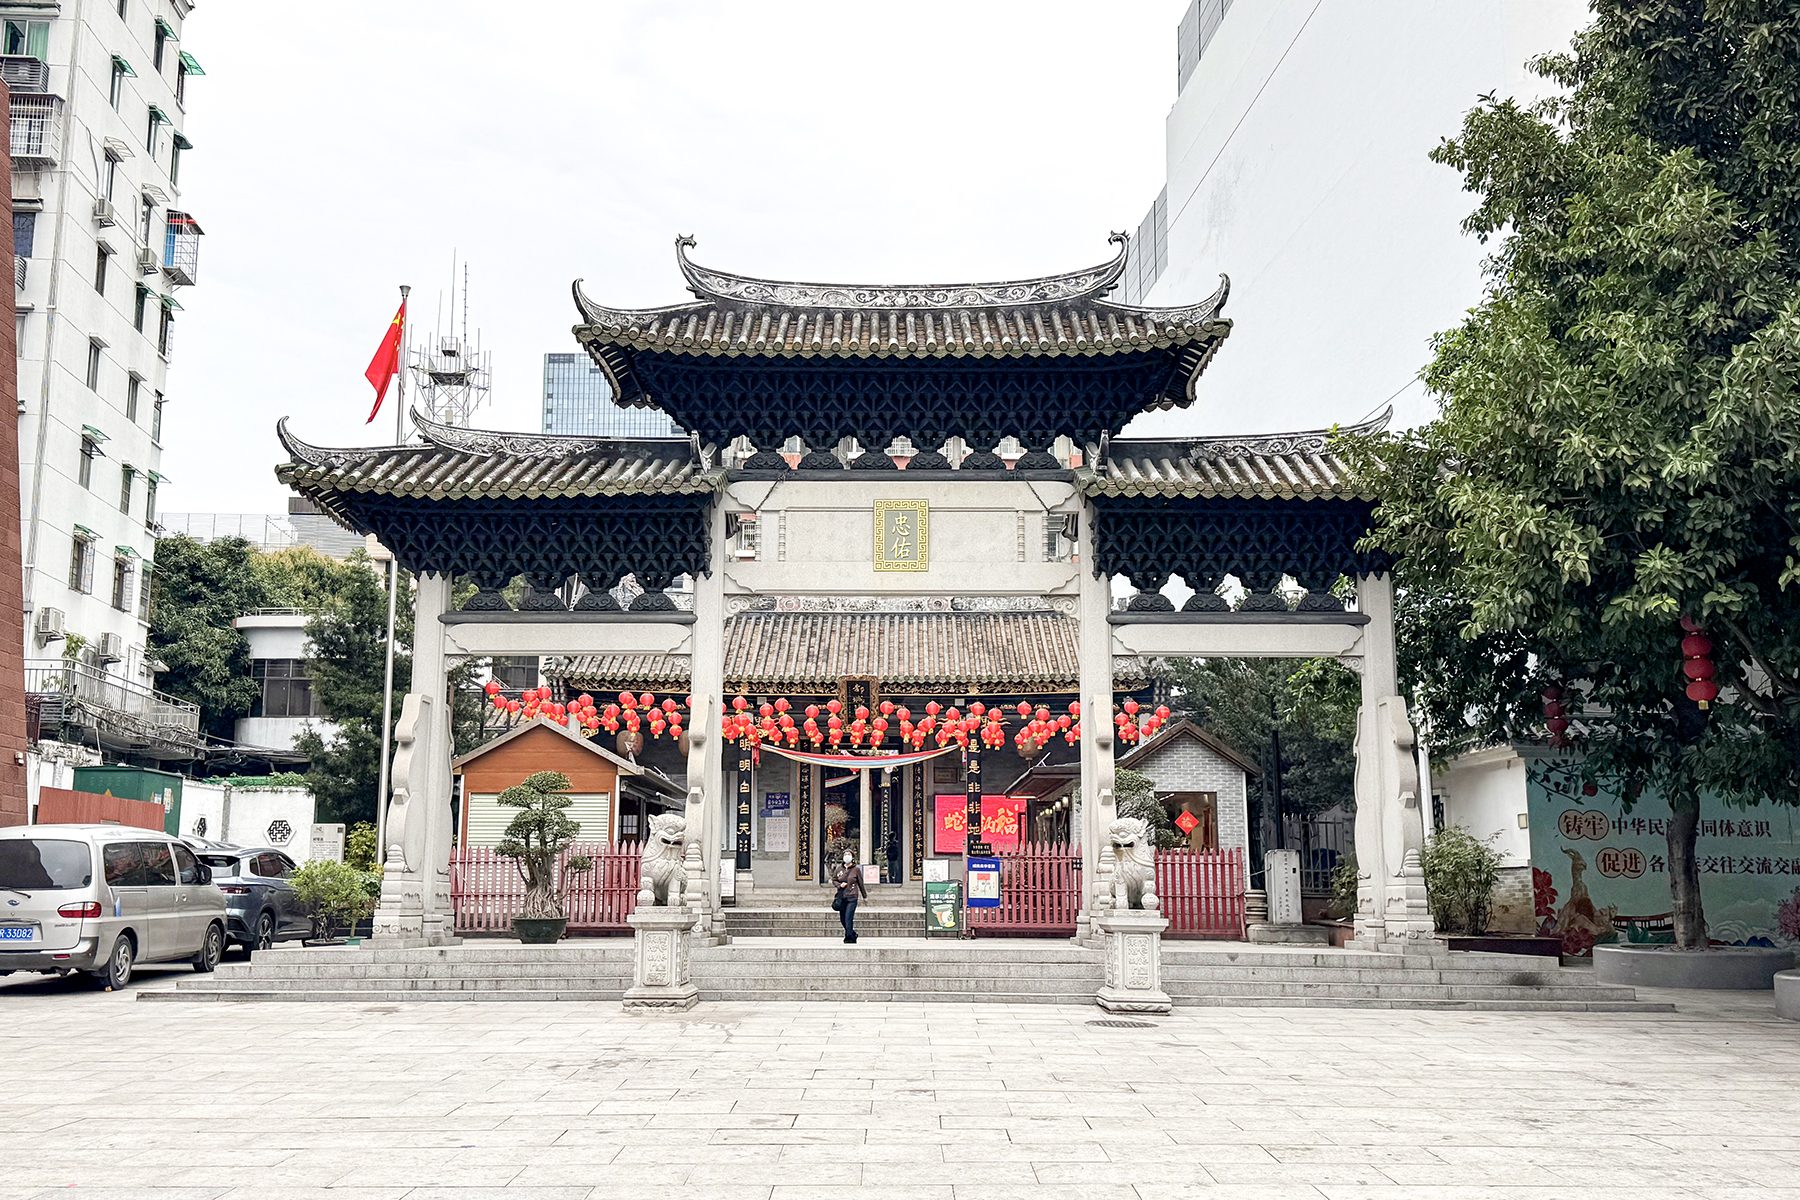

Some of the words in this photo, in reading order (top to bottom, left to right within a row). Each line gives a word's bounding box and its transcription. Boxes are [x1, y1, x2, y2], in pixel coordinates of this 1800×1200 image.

[890, 511, 912, 559] 忠佑
[1564, 815, 1772, 838] 铸牢中华民同体意识
